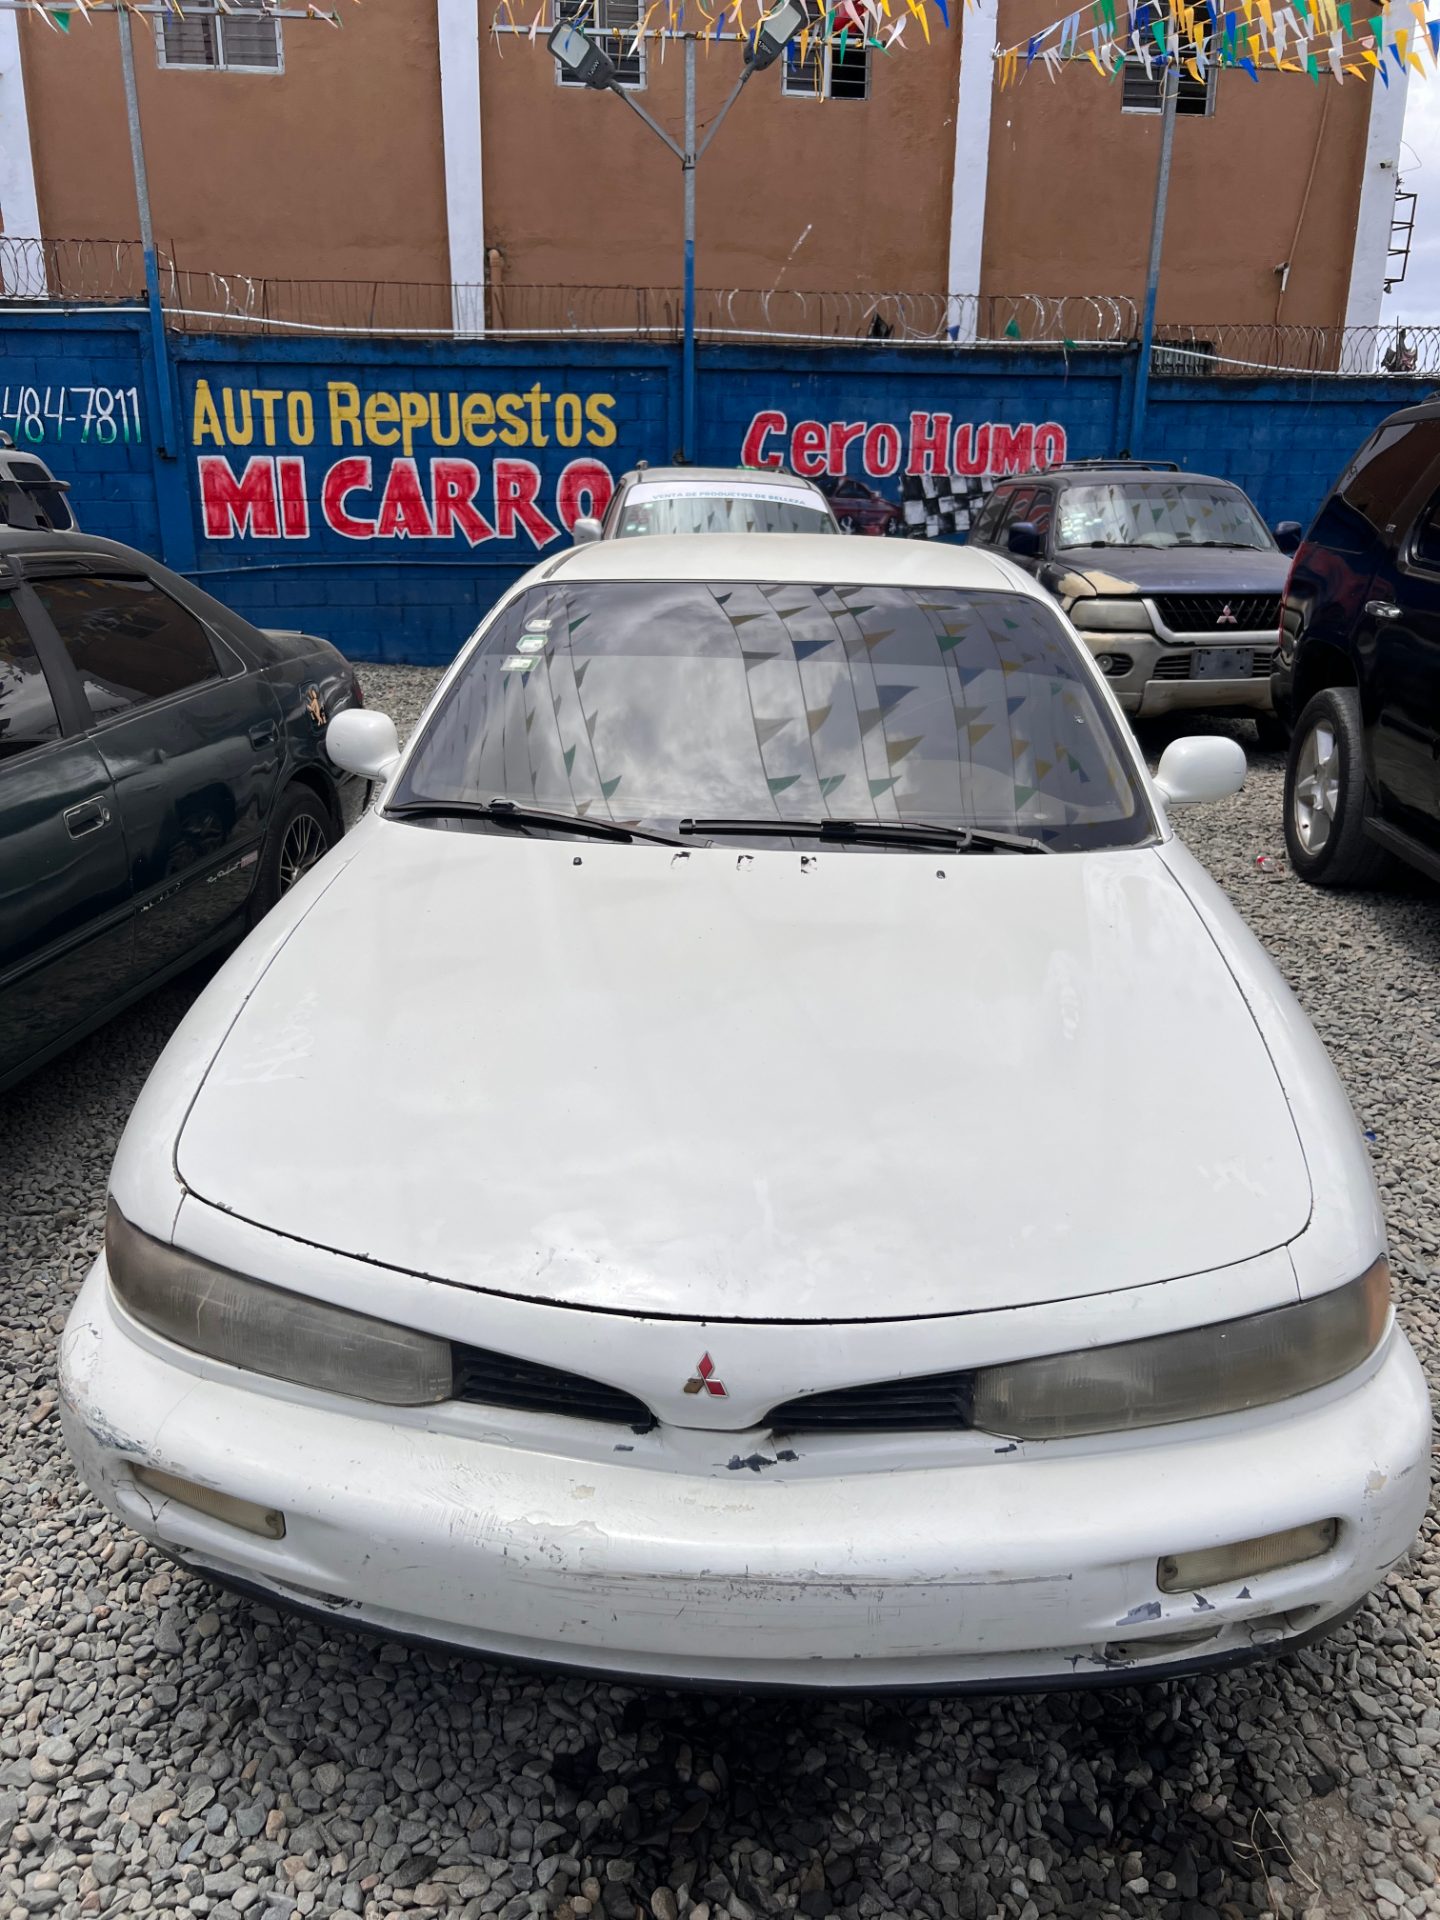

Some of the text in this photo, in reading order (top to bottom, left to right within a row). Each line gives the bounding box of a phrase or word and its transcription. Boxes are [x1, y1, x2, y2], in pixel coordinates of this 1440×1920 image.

[2, 386, 142, 443] 484-7811
[192, 379, 617, 457] AUTO Repuestos
[741, 410, 1066, 478] Cero HUMO
[197, 455, 614, 550] MI CARRO
[652, 492, 683, 500] VENTA
[768, 494, 806, 505] BELLEZA
